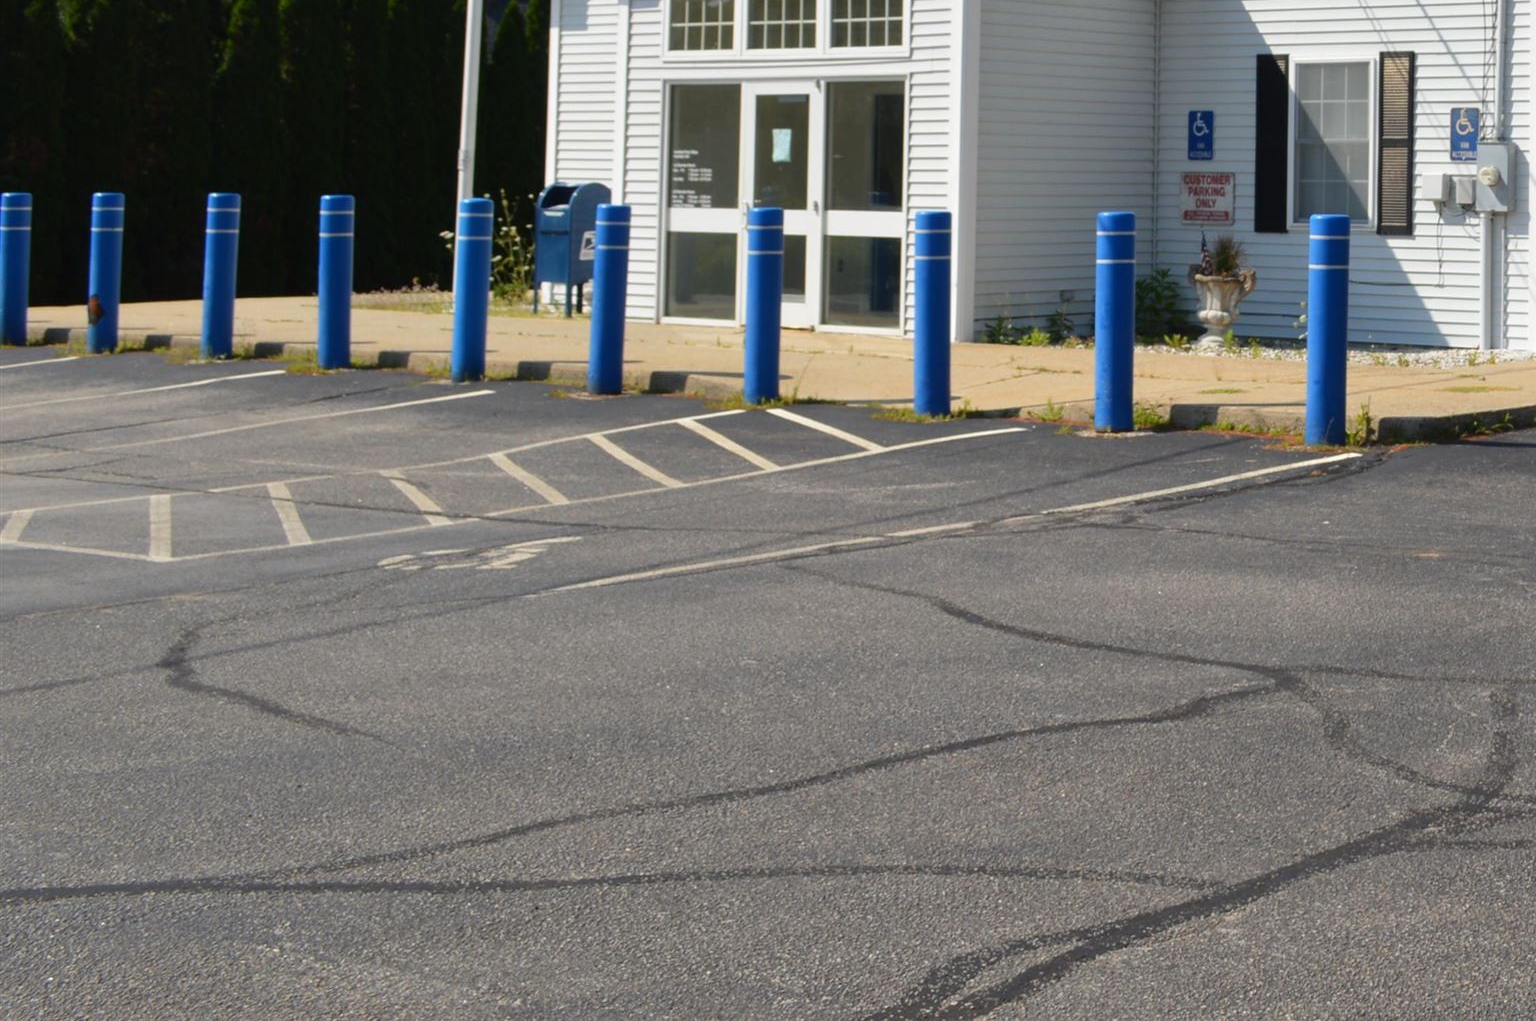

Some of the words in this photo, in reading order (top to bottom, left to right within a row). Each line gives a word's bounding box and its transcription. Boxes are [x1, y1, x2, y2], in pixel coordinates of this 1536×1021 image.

[1183, 174, 1231, 185] CUSTOMER
[1188, 186, 1225, 197] PARKING
[1195, 198, 1217, 209] ONLY
